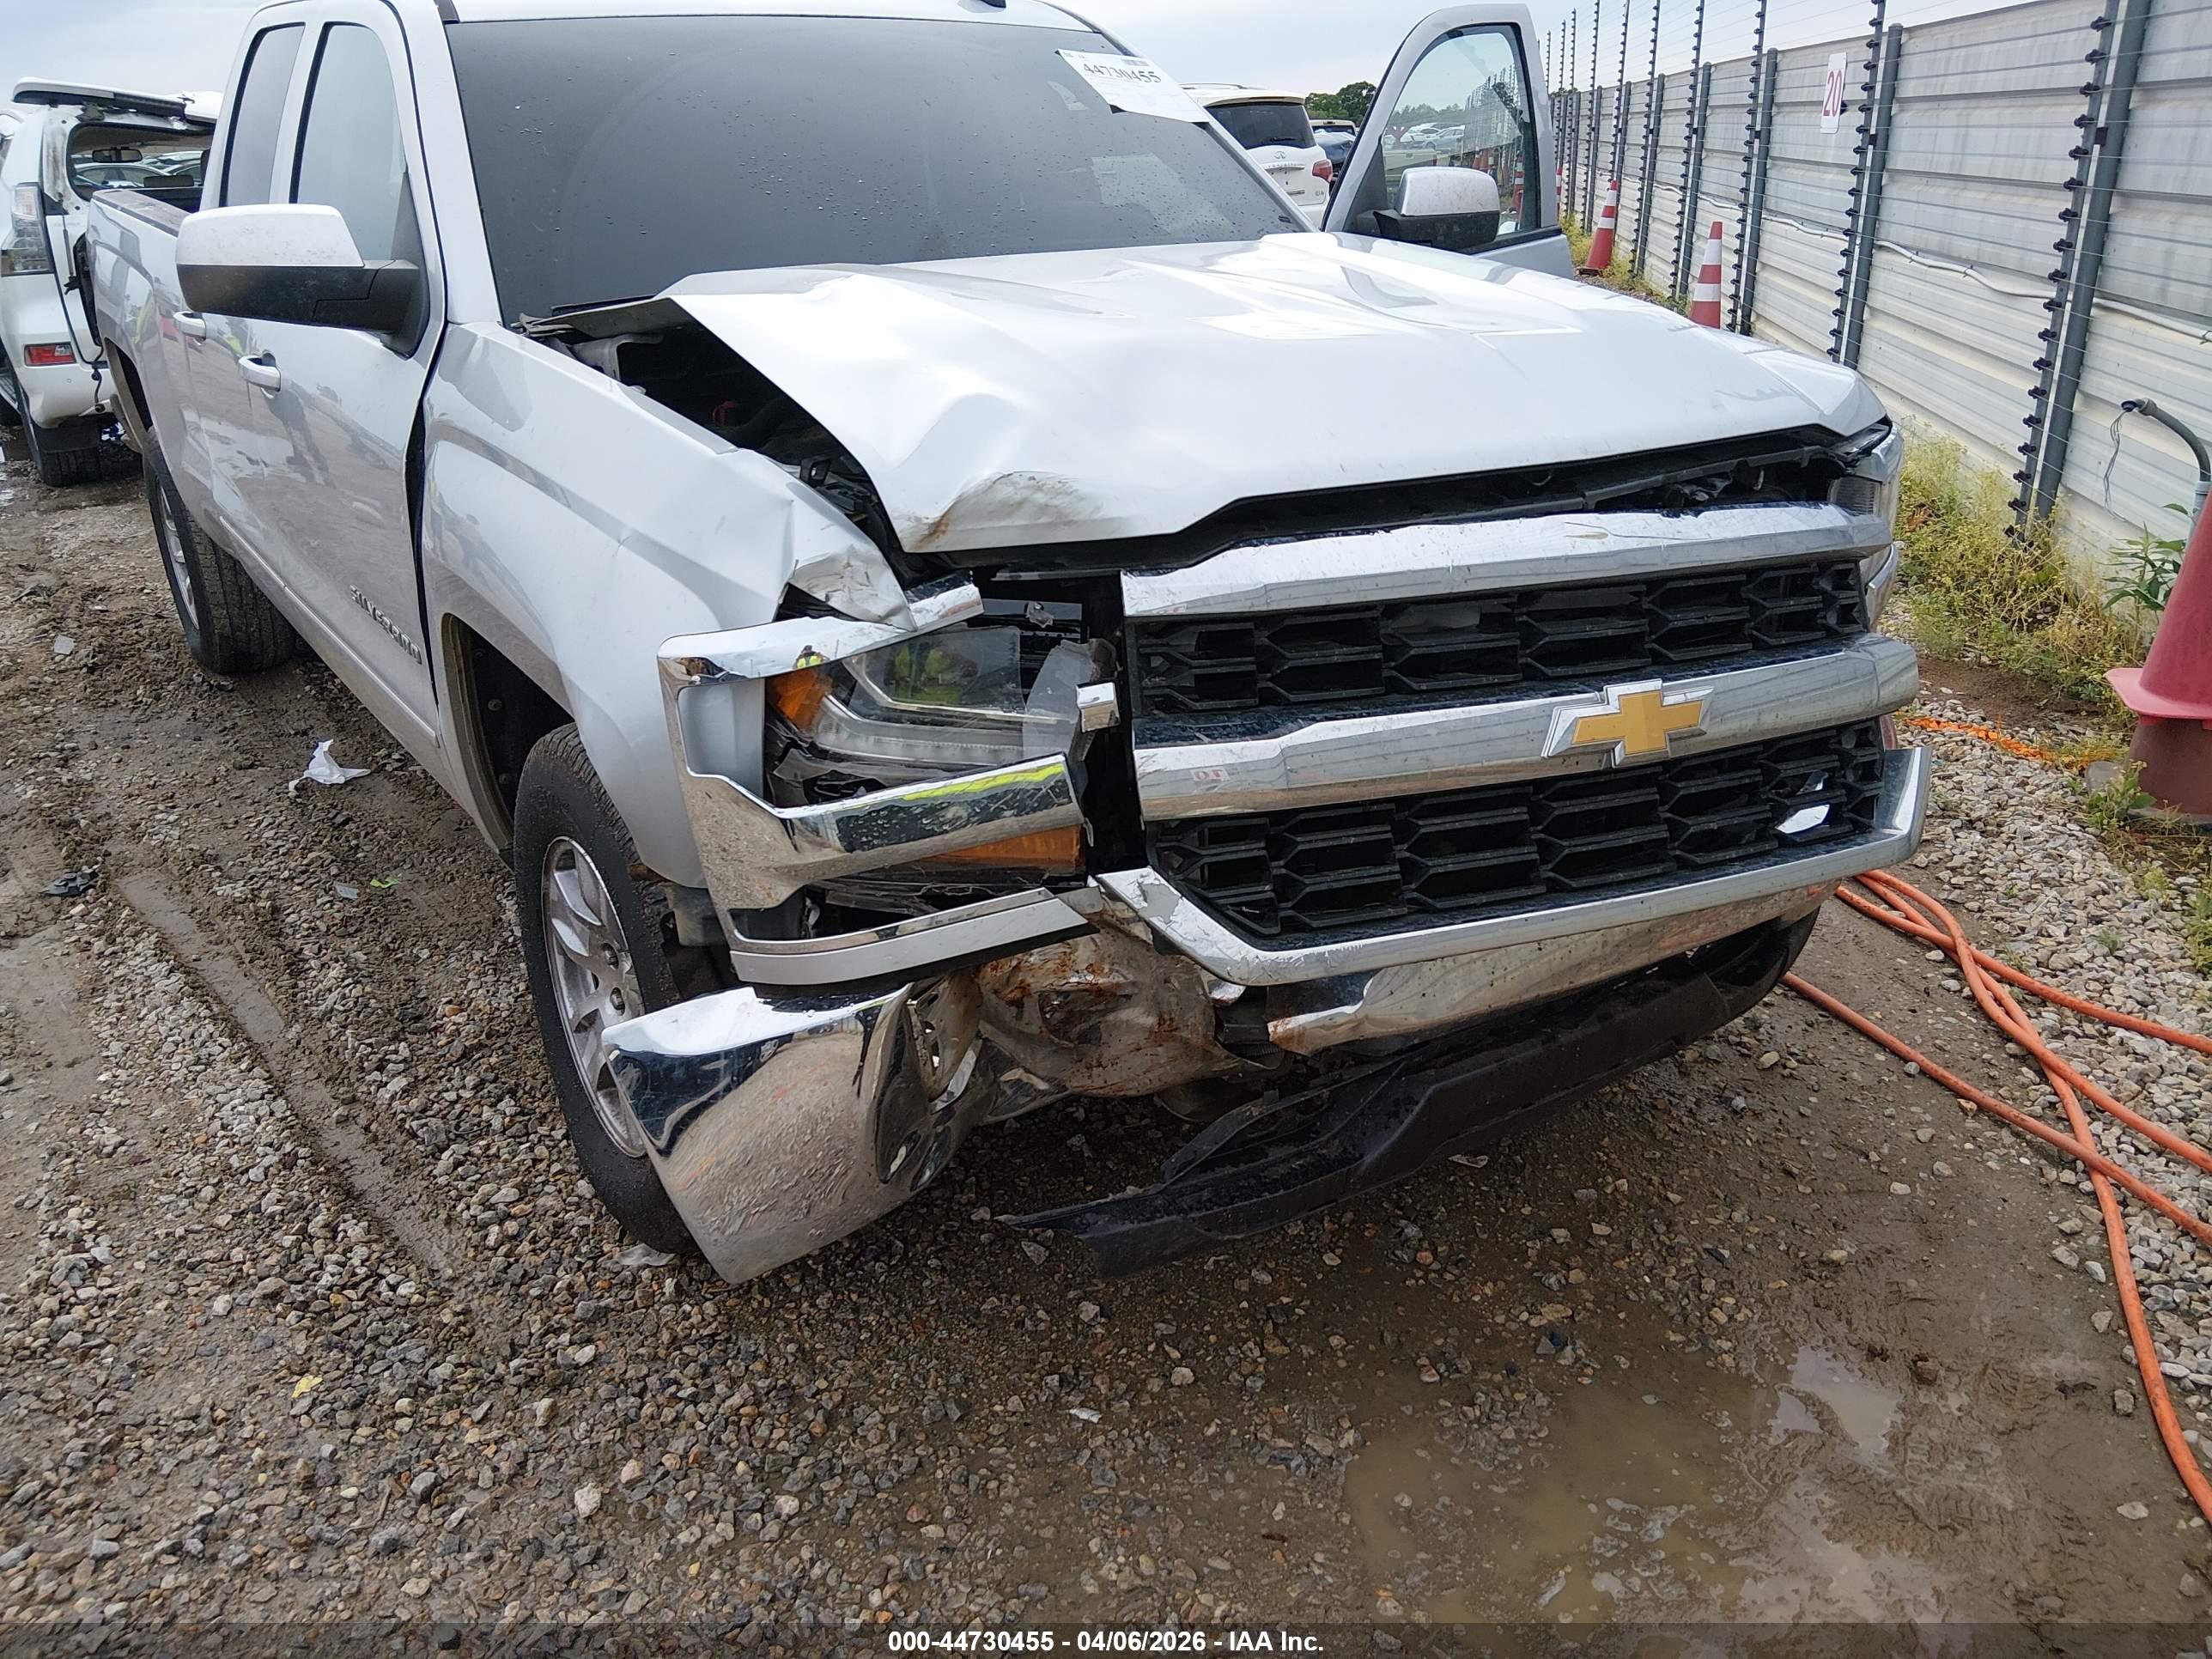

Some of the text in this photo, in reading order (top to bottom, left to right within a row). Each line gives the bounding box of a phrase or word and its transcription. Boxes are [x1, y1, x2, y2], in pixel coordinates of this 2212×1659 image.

[1083, 63, 1162, 83] 44730455
[1823, 70, 1842, 117] 20
[349, 584, 422, 665] SILVERADO
